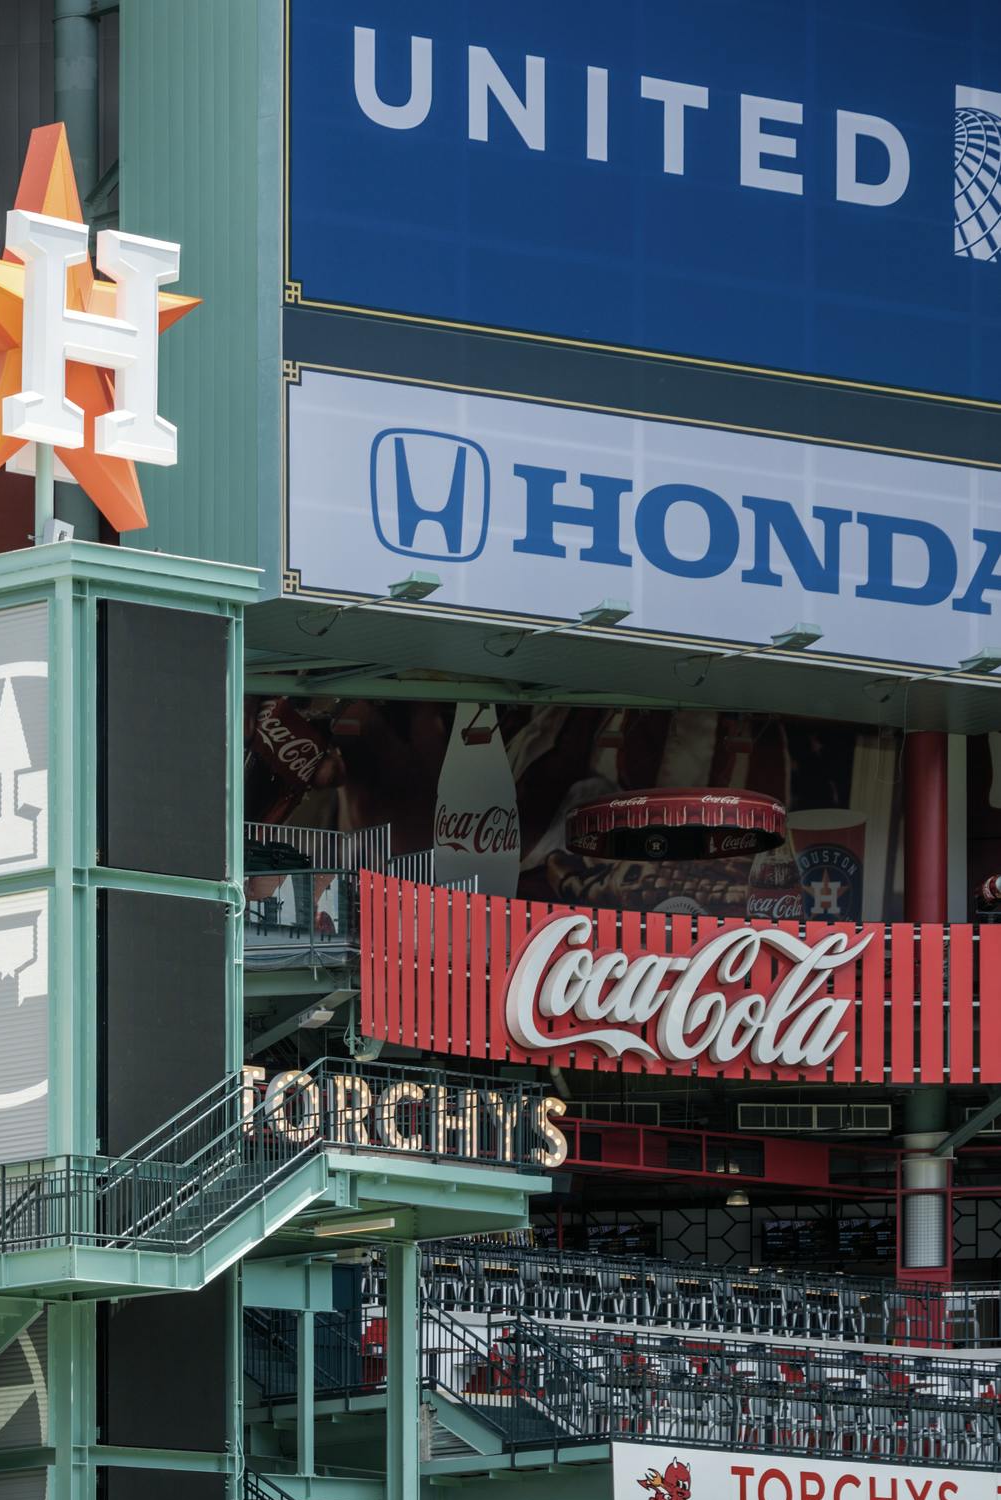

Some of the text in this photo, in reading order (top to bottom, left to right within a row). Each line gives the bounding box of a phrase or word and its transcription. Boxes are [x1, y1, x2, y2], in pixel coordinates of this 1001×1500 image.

[353, 26, 911, 207] UNITED
[434, 804, 519, 854] Coca-Cola
[800, 849, 858, 876] OUSTON
[505, 914, 876, 1067] Coca-Cola
[242, 1065, 568, 1168] TORCHYS
